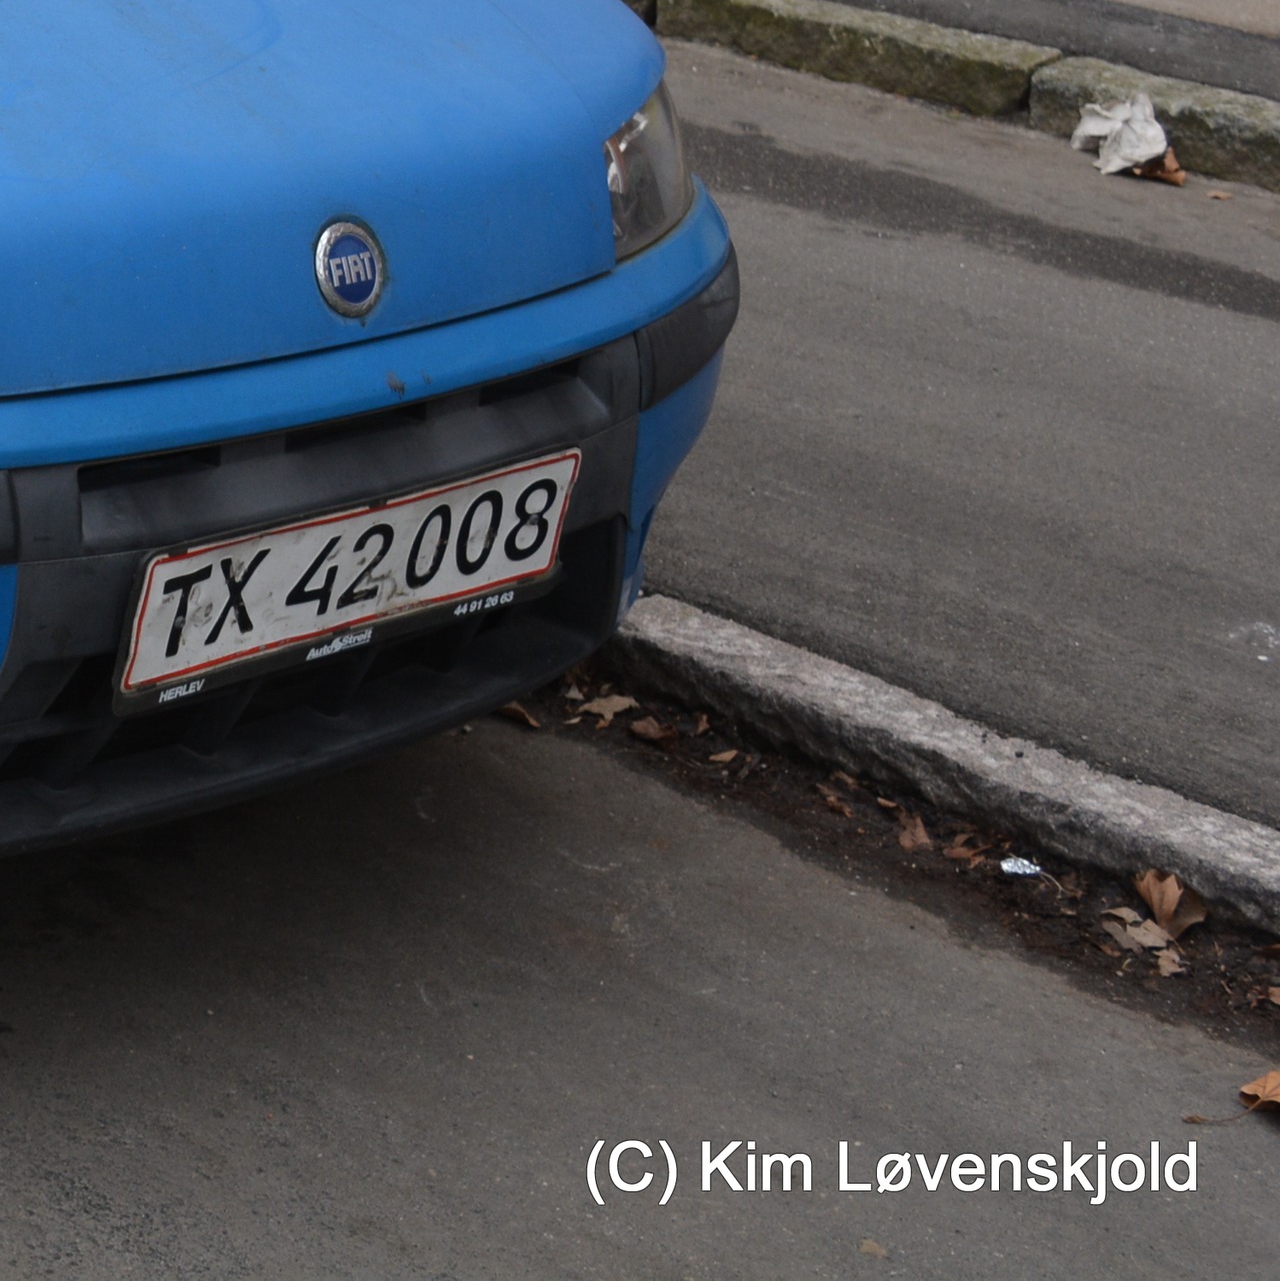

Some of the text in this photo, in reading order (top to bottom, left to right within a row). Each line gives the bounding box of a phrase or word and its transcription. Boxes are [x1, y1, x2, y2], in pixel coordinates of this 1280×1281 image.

[329, 250, 373, 288] FIAT
[163, 548, 272, 658] TX
[159, 679, 205, 703] HERLEV
